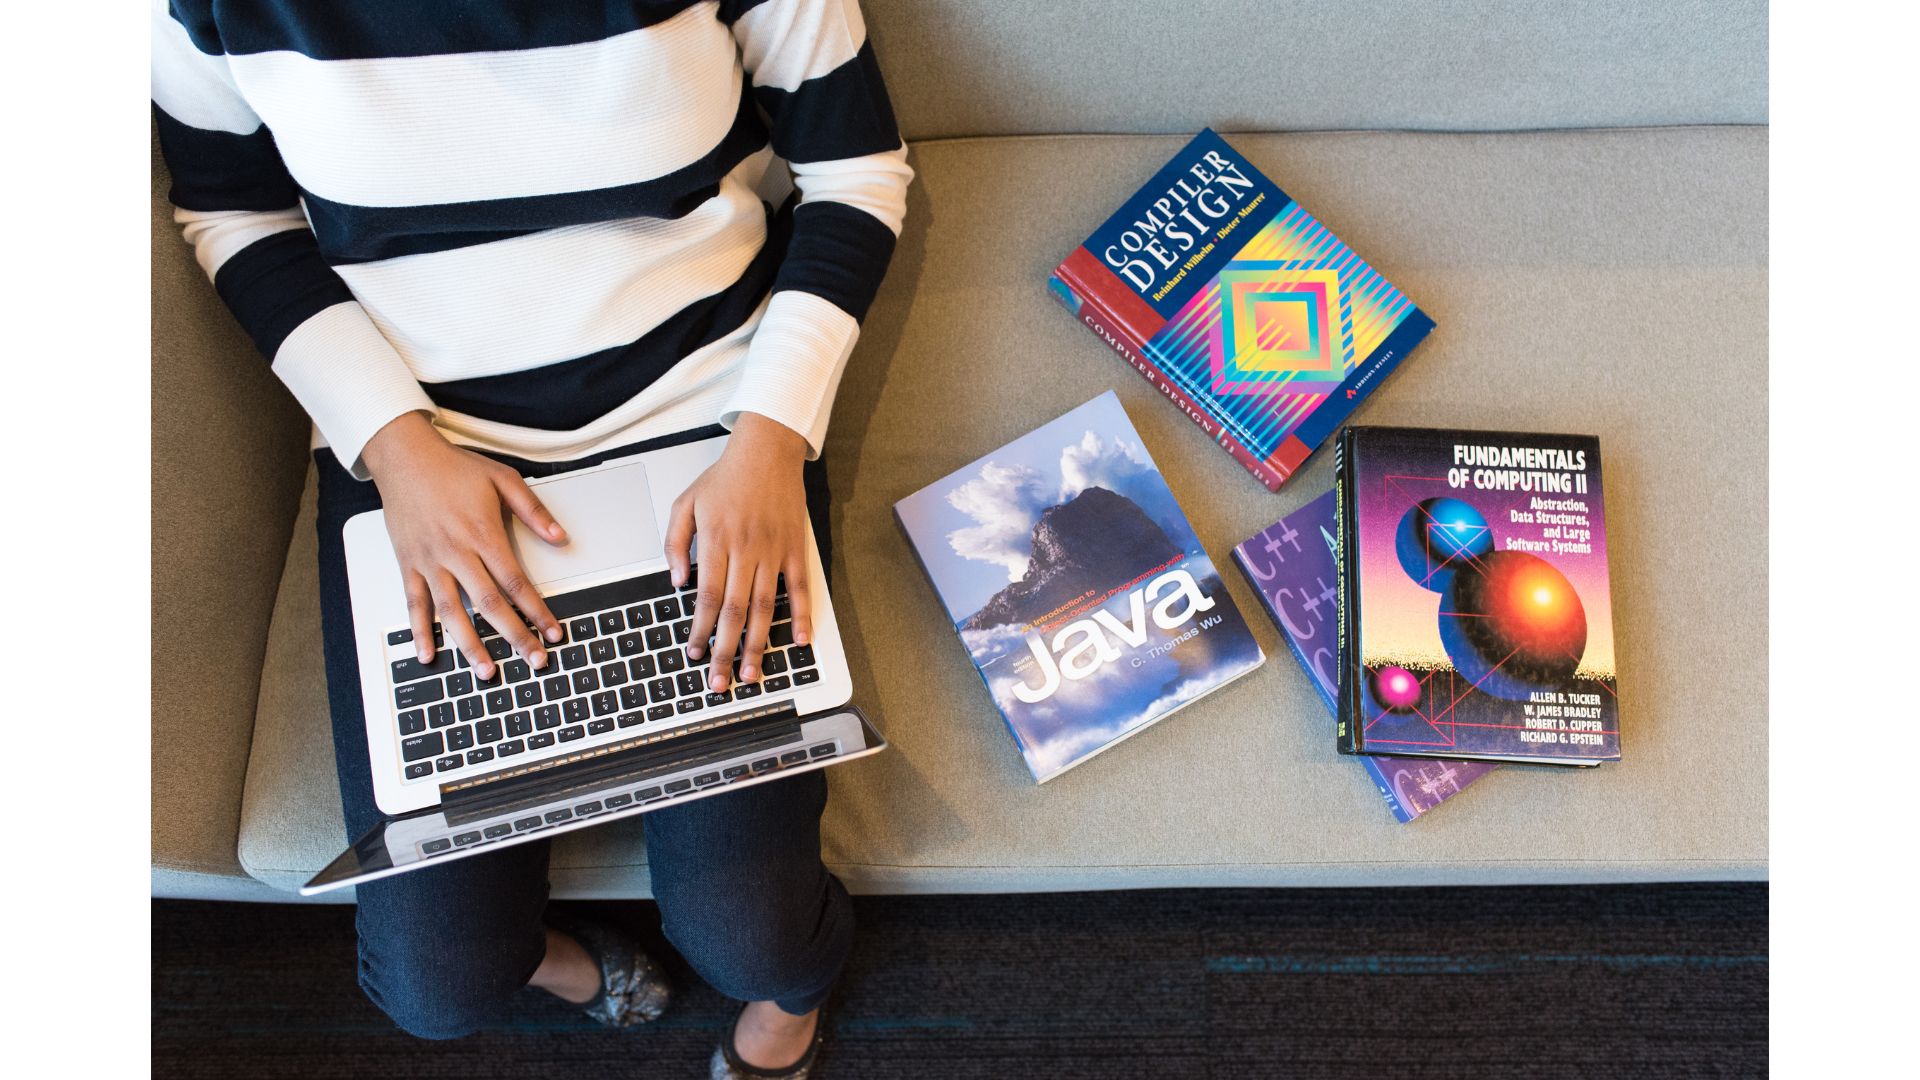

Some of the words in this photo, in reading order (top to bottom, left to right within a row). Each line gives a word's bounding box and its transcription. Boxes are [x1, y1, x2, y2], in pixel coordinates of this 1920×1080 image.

[1104, 149, 1231, 268] COMPILER
[1120, 164, 1254, 293] DESIGN
[1152, 267, 1187, 302] Reinhard
[1183, 241, 1215, 274] Wilhelm
[1216, 214, 1242, 240] Dieter
[1237, 192, 1266, 221] Maurer
[1085, 314, 1157, 383] COMPILER
[1160, 382, 1213, 434] DESIGN
[1453, 445, 1586, 471] FUNDAMENTALS
[1448, 468, 1470, 488] OF
[1473, 469, 1572, 493] COMPUTING
[1575, 473, 1587, 494] II
[1530, 497, 1589, 513] Abstraction,
[1510, 510, 1534, 523] Data
[1536, 511, 1590, 527] Structures,
[1506, 537, 1550, 551] Software
[1552, 540, 1591, 555] Systems
[1543, 526, 1561, 538] and
[1563, 526, 1590, 542] Large
[1033, 596, 1085, 627] Introduction
[1085, 590, 1096, 599] to
[1011, 569, 1215, 703] Java
[1131, 657, 1147, 668] C.
[1147, 628, 1199, 659] Thomas
[1199, 614, 1223, 633] Wu
[1524, 704, 1535, 716] W.
[1536, 705, 1562, 718] JAMES
[1564, 706, 1602, 718] BRADLEY
[1530, 692, 1556, 703] ALLEN
[1558, 693, 1567, 704] B.
[1568, 693, 1601, 705] TUCKER
[1520, 731, 1557, 743] RICHARD
[1559, 732, 1569, 744] G.
[1570, 733, 1603, 745] EPSTEIN
[1525, 718, 1557, 730] ROBERT
[1559, 719, 1568, 730] D.
[1569, 720, 1602, 732] CUPPER
